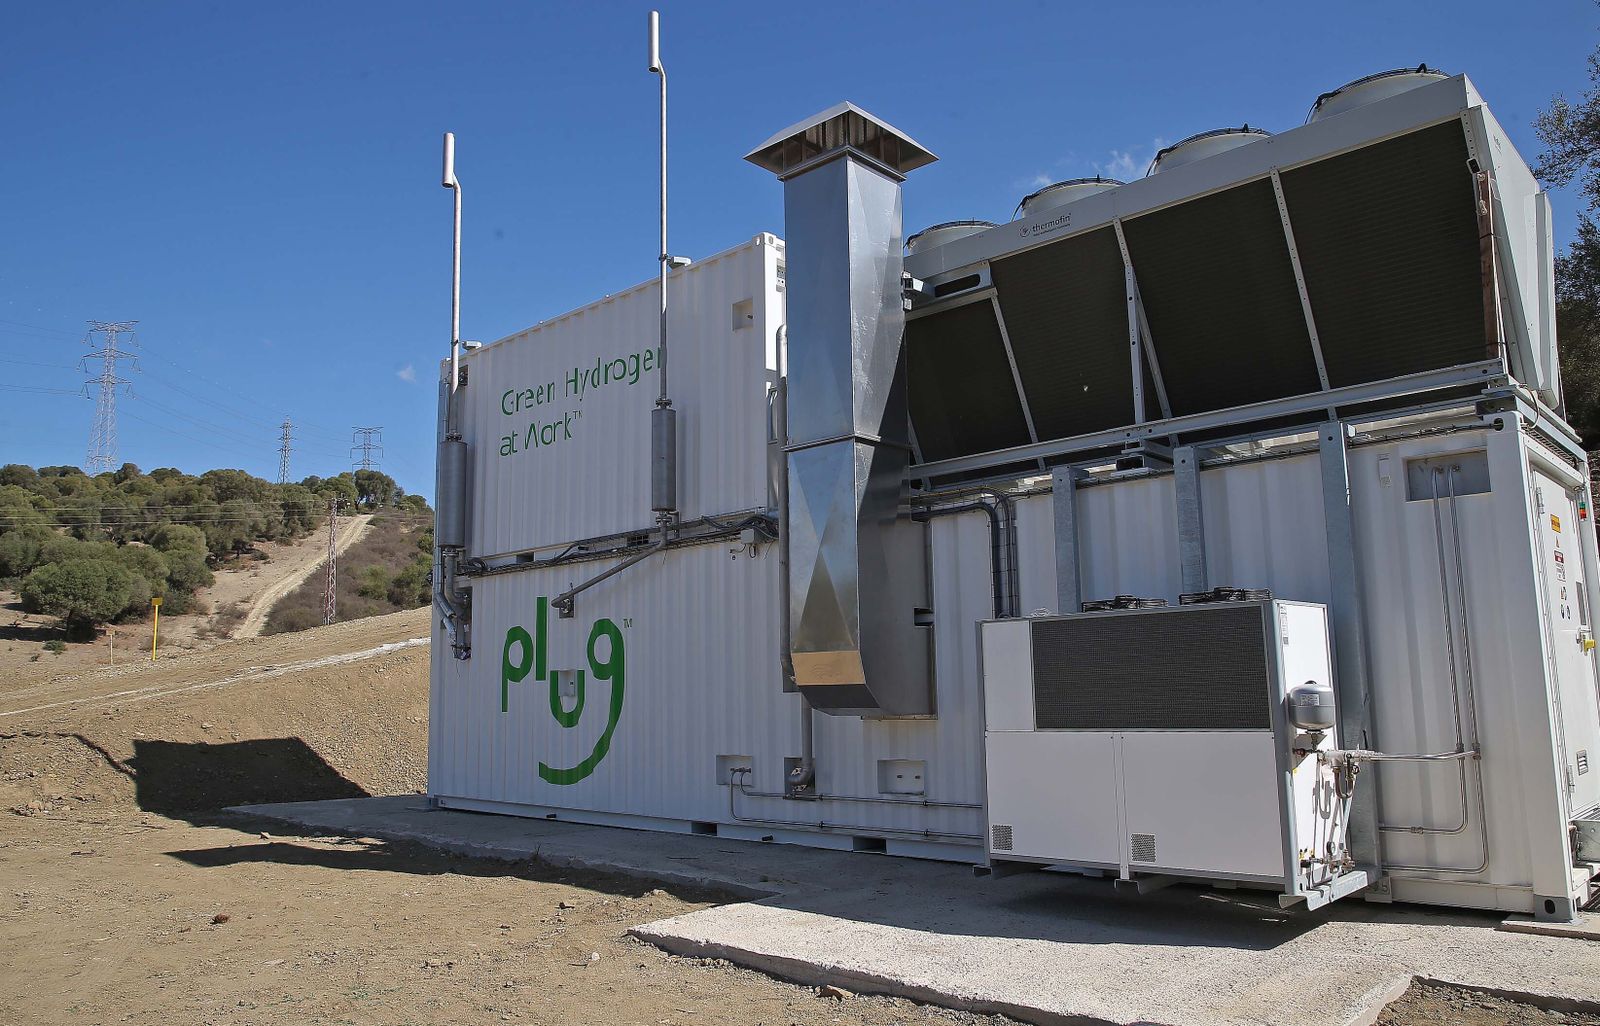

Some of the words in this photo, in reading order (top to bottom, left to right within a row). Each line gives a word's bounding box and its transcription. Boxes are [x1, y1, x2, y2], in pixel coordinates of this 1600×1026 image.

[501, 381, 555, 416] Green
[500, 430, 518, 456] at
[501, 596, 625, 786] plug
